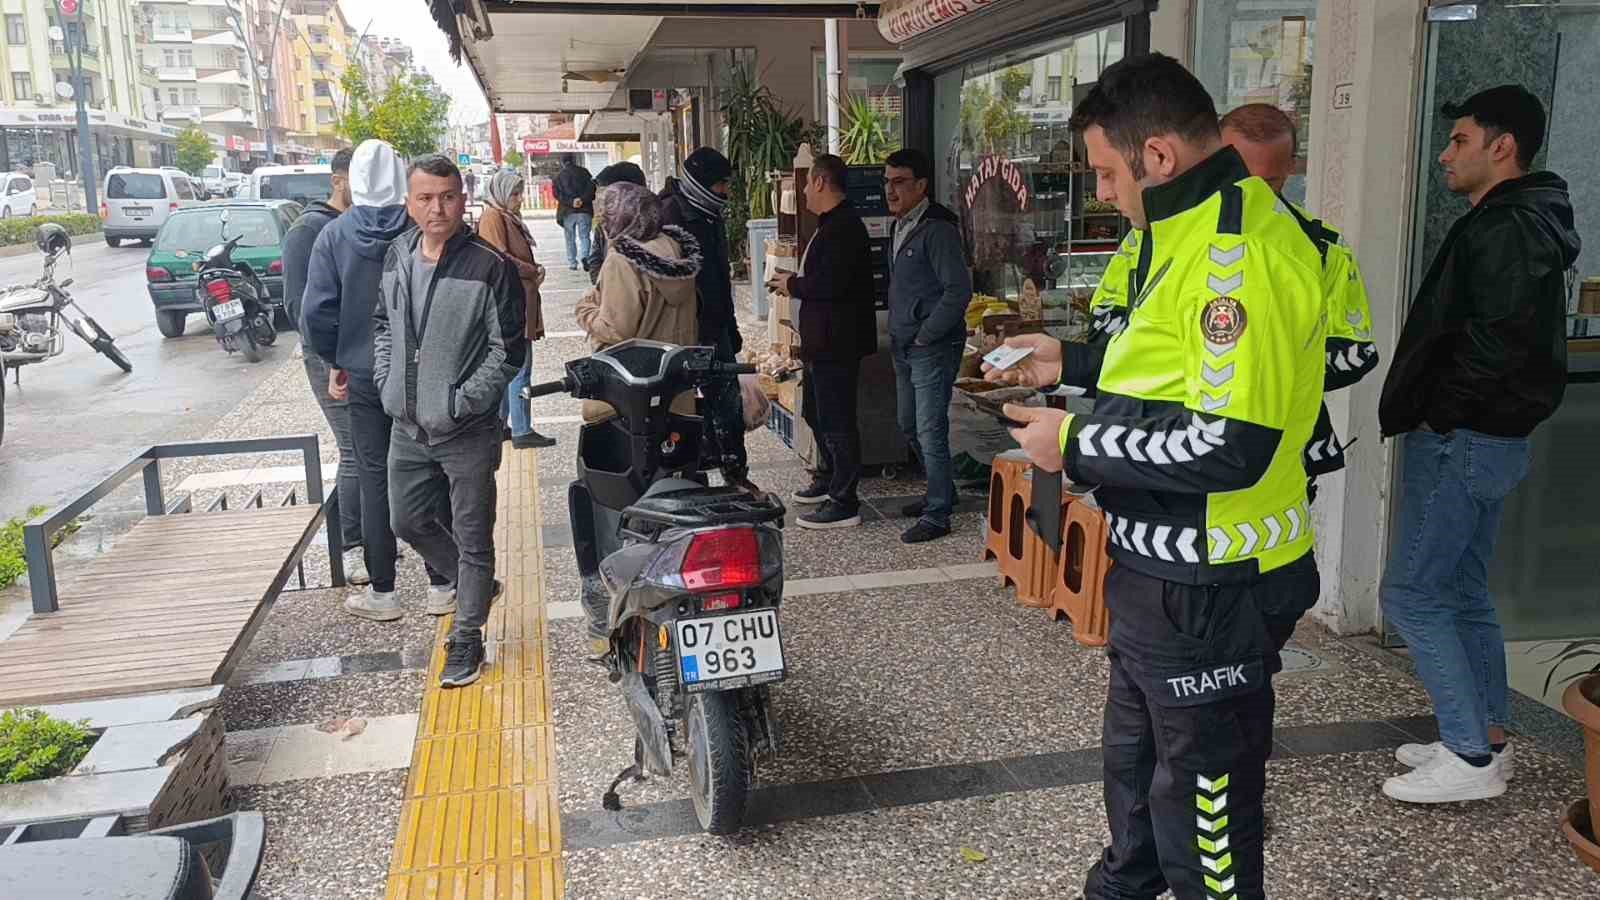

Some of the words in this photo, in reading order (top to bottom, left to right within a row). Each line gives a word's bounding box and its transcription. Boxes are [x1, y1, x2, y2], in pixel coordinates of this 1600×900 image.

[965, 155, 1000, 209] HATAY
[1000, 158, 1028, 211] GIDA
[682, 622, 714, 648] 07
[723, 614, 775, 643] CHU
[705, 645, 757, 675] 963
